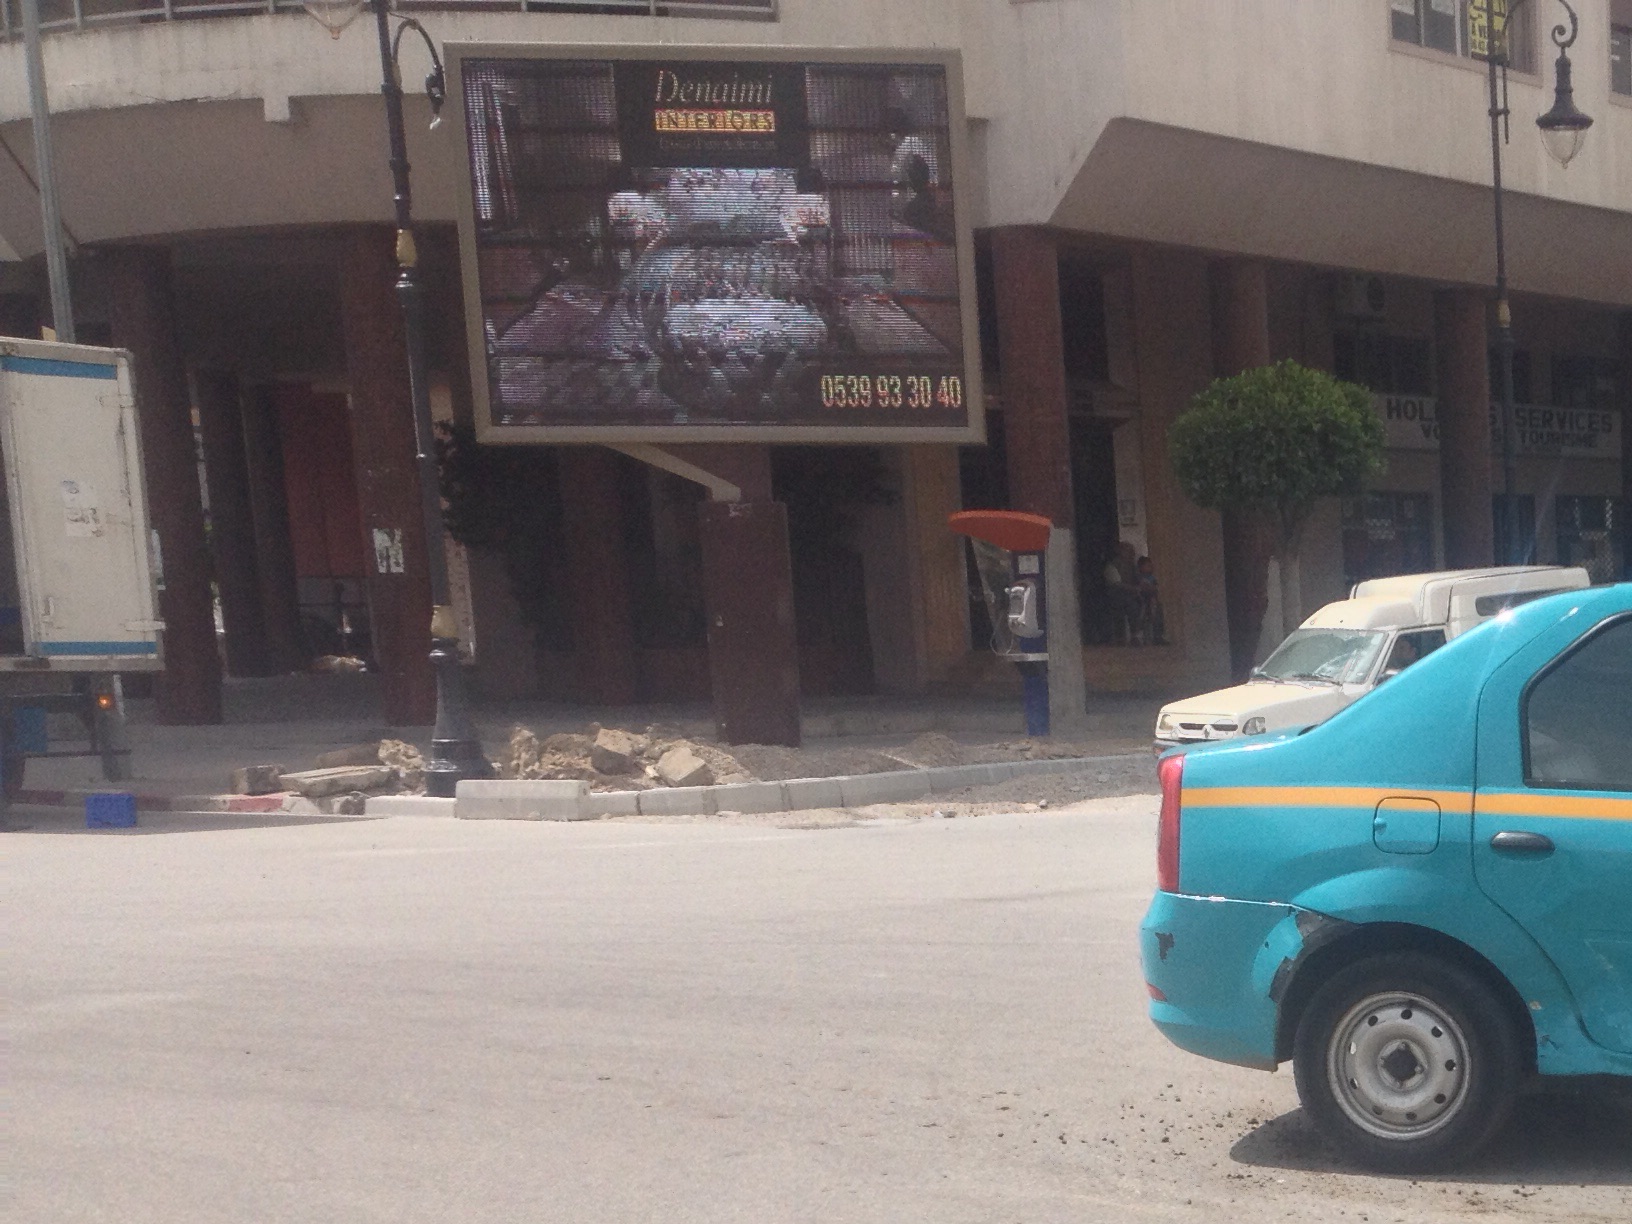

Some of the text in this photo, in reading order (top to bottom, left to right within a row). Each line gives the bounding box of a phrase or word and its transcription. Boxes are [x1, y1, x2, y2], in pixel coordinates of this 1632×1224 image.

[655, 70, 774, 104] Denaimi
[656, 111, 774, 130] INTERIORS
[821, 374, 962, 408] 0539 93 30 40
[1514, 407, 1613, 433] SERVICES
